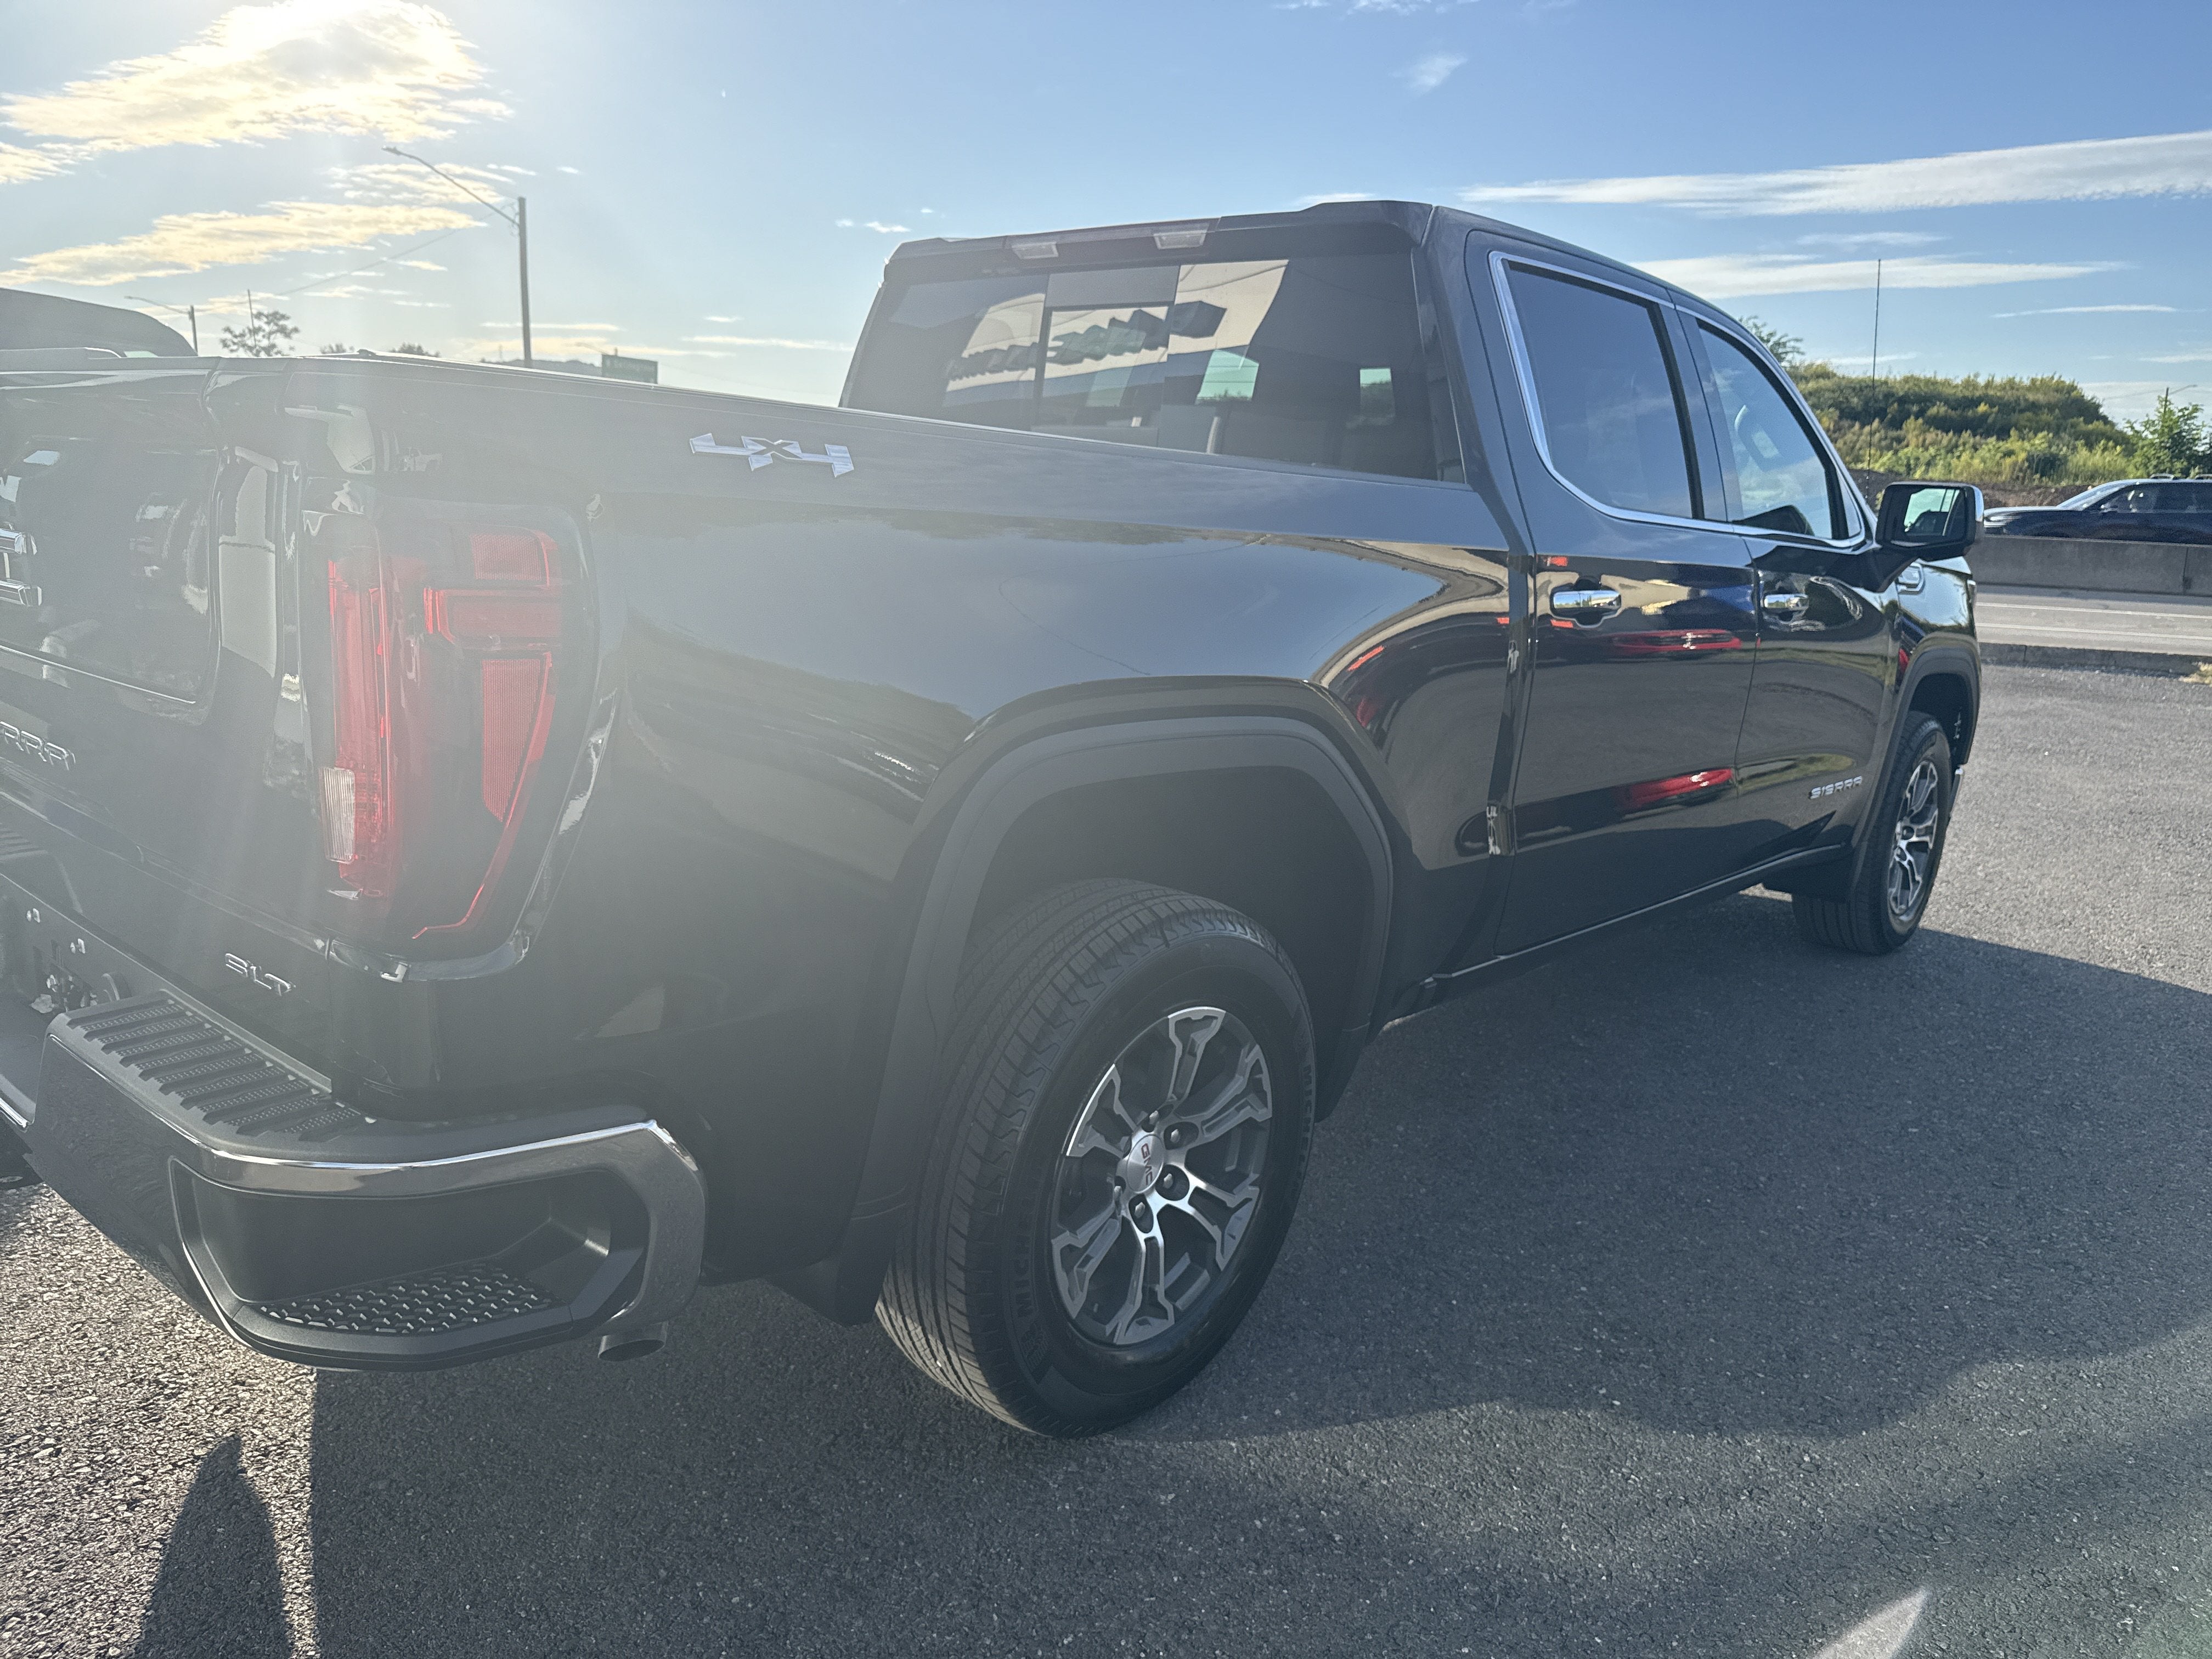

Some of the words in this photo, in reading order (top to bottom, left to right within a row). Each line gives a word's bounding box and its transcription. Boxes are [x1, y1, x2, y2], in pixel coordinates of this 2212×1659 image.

[1810, 775, 1863, 799] SIERRA
[224, 953, 294, 997] SLT
[1141, 1143, 1153, 1186] GMC
